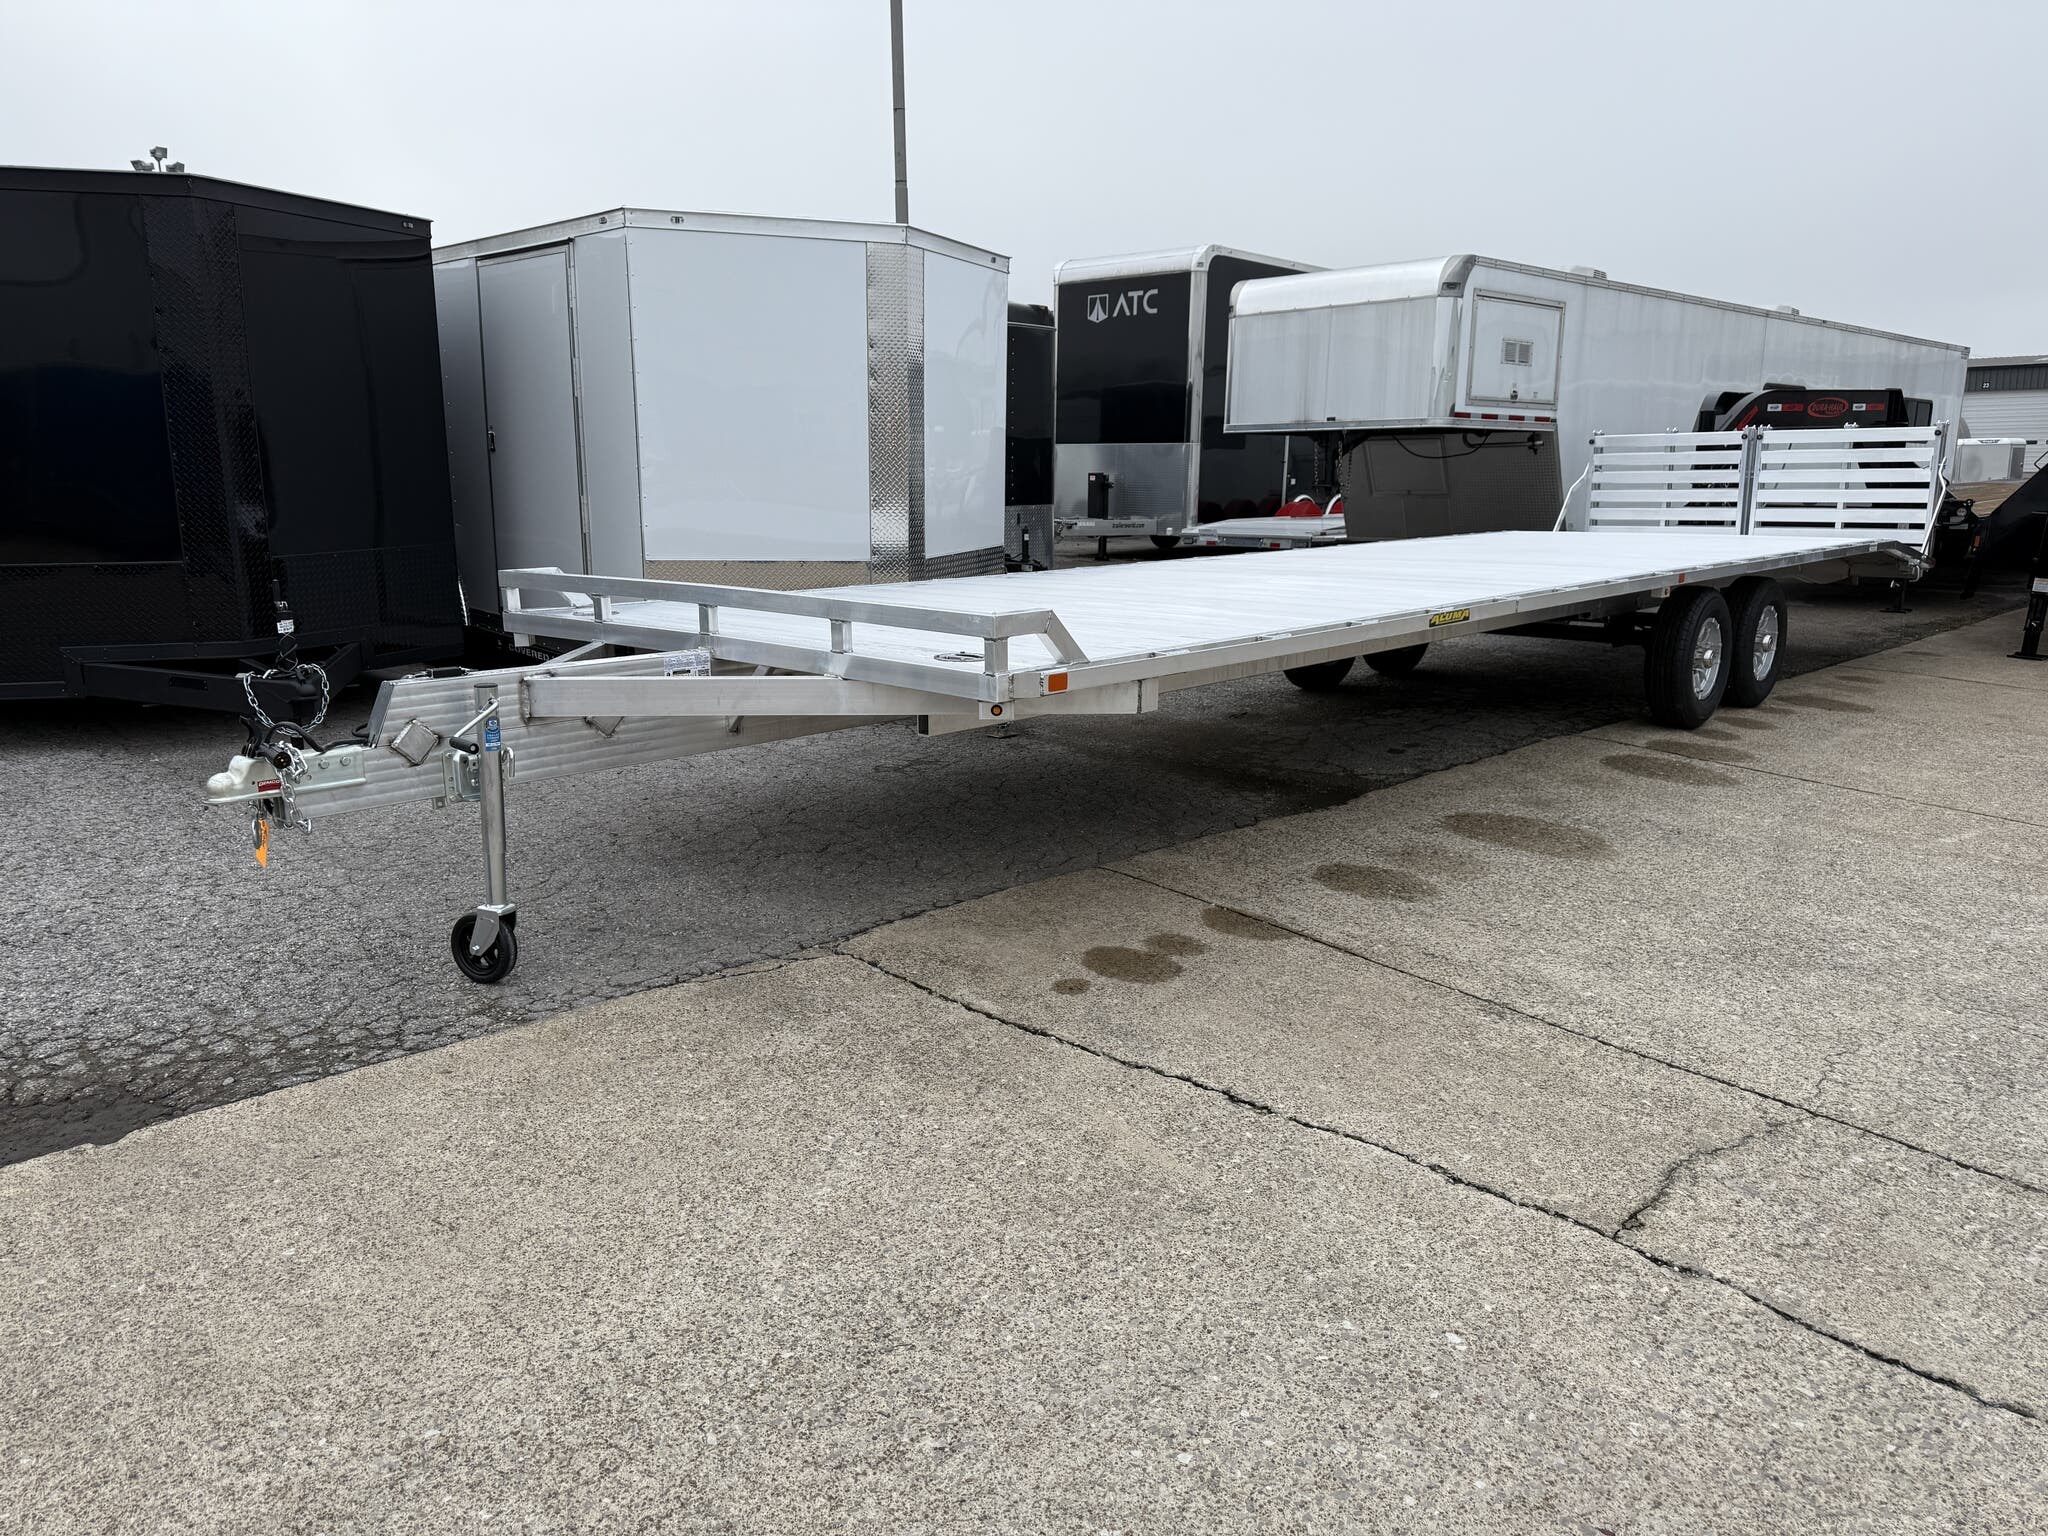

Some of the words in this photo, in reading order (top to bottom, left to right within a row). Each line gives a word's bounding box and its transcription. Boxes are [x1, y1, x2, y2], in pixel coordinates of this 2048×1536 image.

[1112, 288, 1159, 318] ATC
[1431, 609, 1469, 625] ALUMA
[508, 643, 549, 660] COVERED
